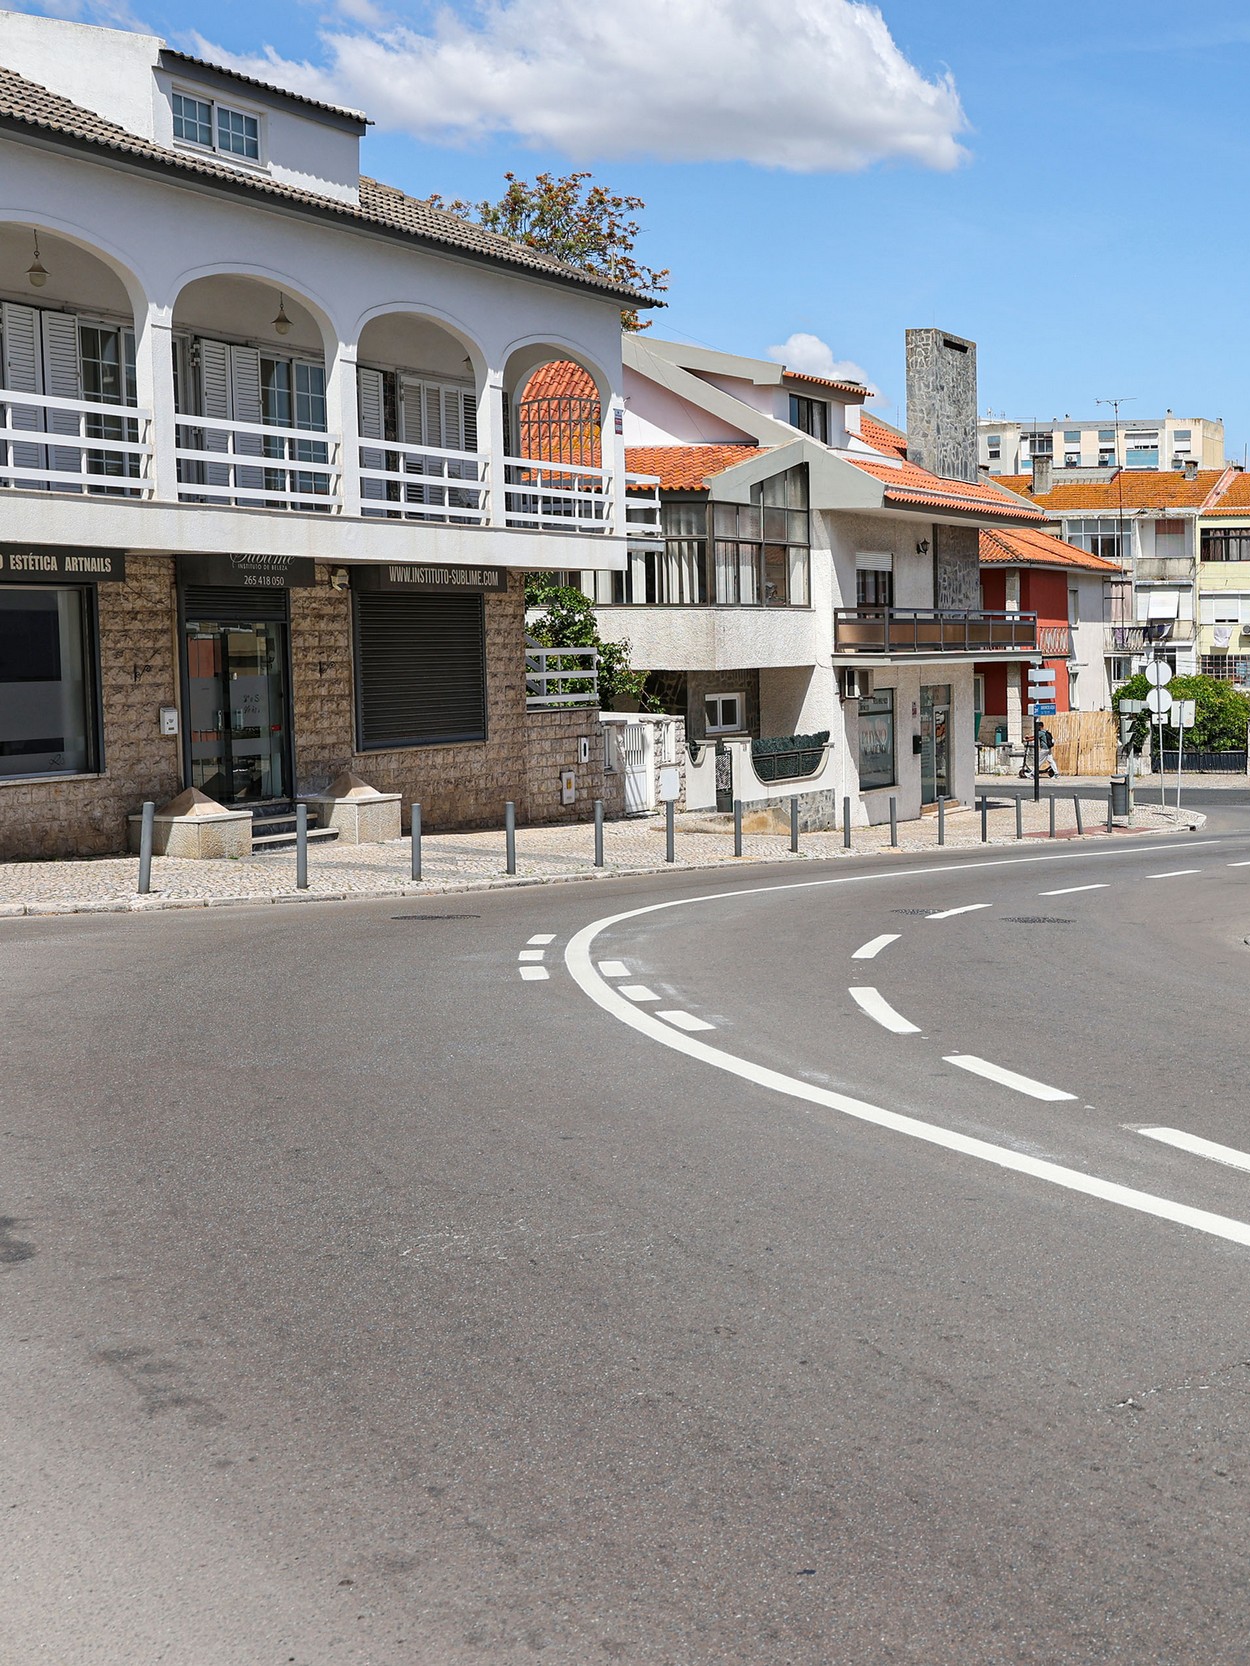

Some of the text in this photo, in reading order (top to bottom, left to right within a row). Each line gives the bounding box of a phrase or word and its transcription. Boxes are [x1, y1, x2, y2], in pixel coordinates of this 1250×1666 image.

[9, 552, 58, 571] ESTÉTICA
[65, 556, 112, 573] ARTNAILS
[244, 575, 285, 586] 265 418 050
[388, 565, 499, 586] WWW.INSTITUTO-SUBLIME.COM
